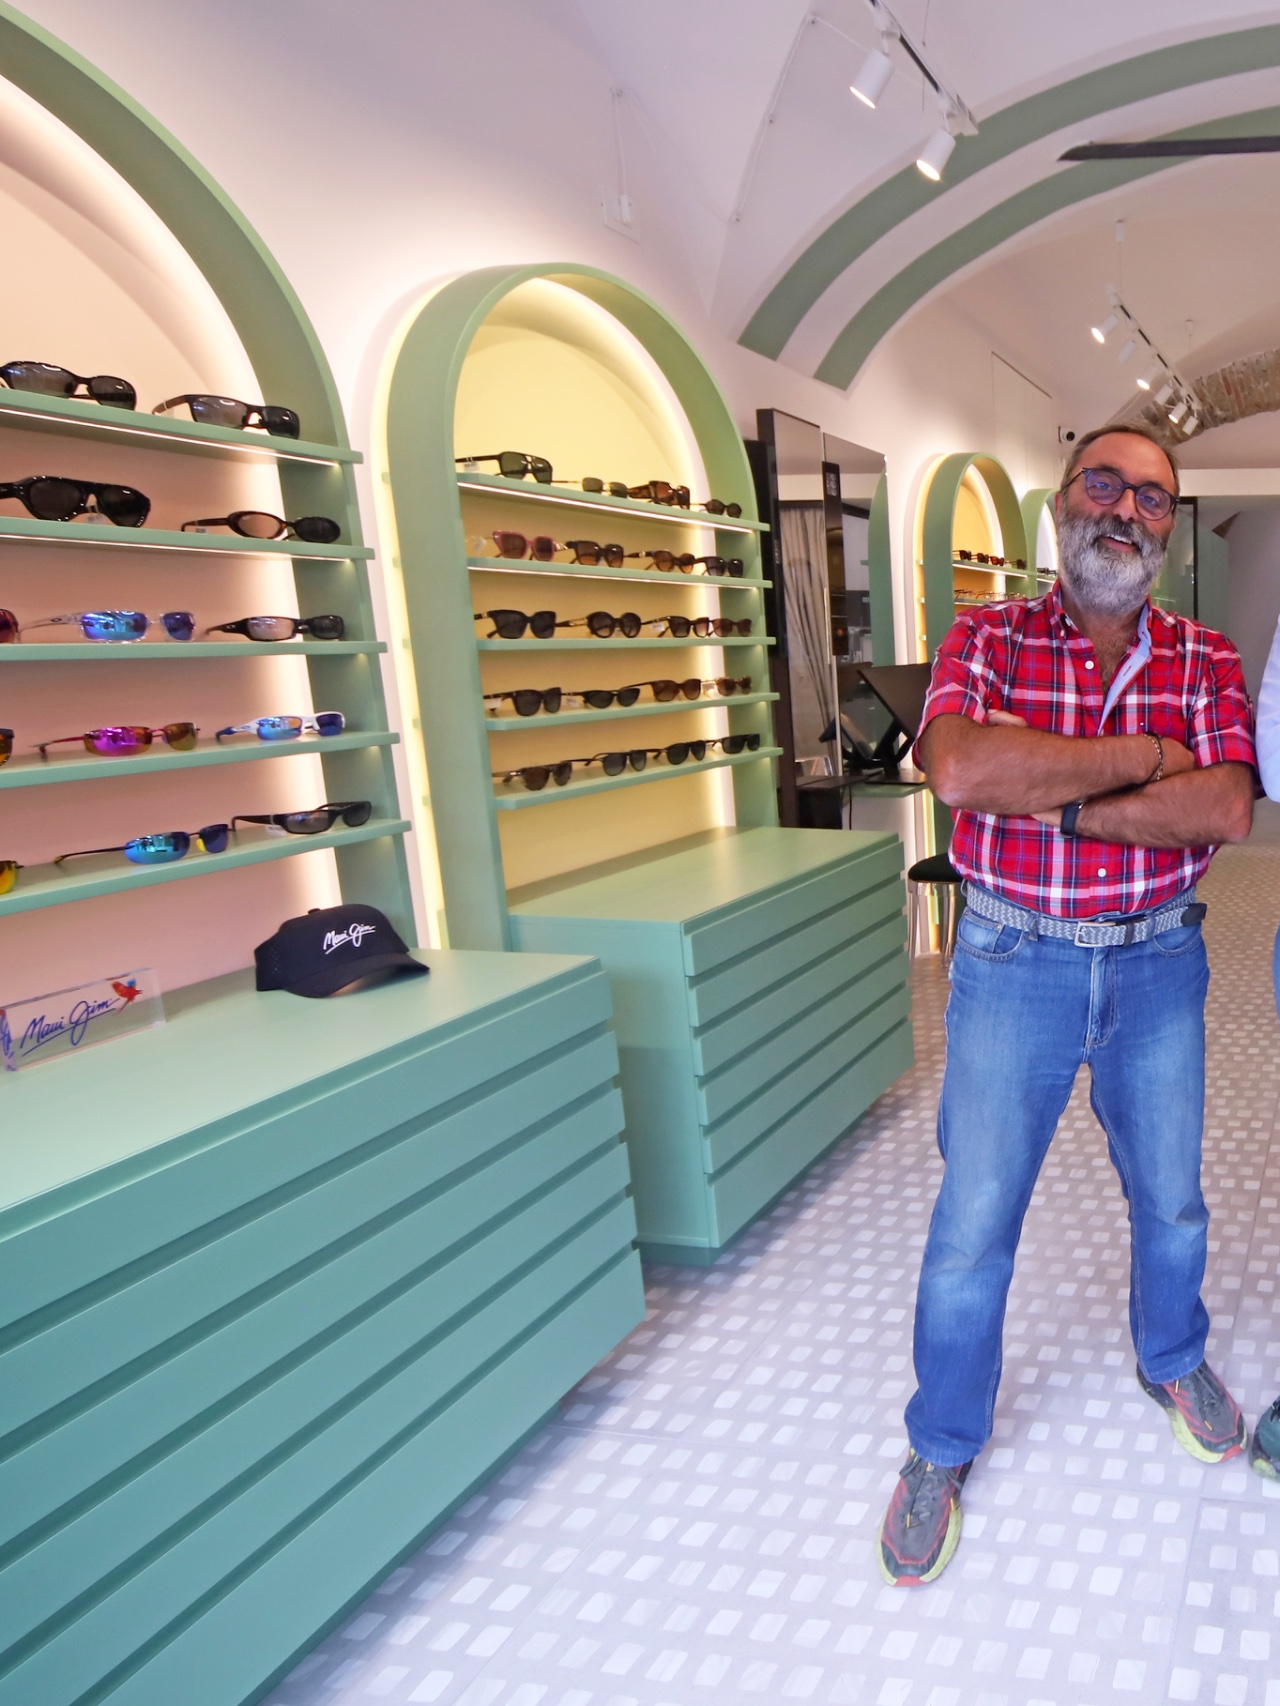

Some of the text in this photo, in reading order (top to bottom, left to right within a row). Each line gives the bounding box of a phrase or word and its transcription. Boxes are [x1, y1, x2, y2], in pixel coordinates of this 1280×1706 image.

[323, 922, 376, 951] Maui Jim
[20, 998, 120, 1049] Maui Jim
